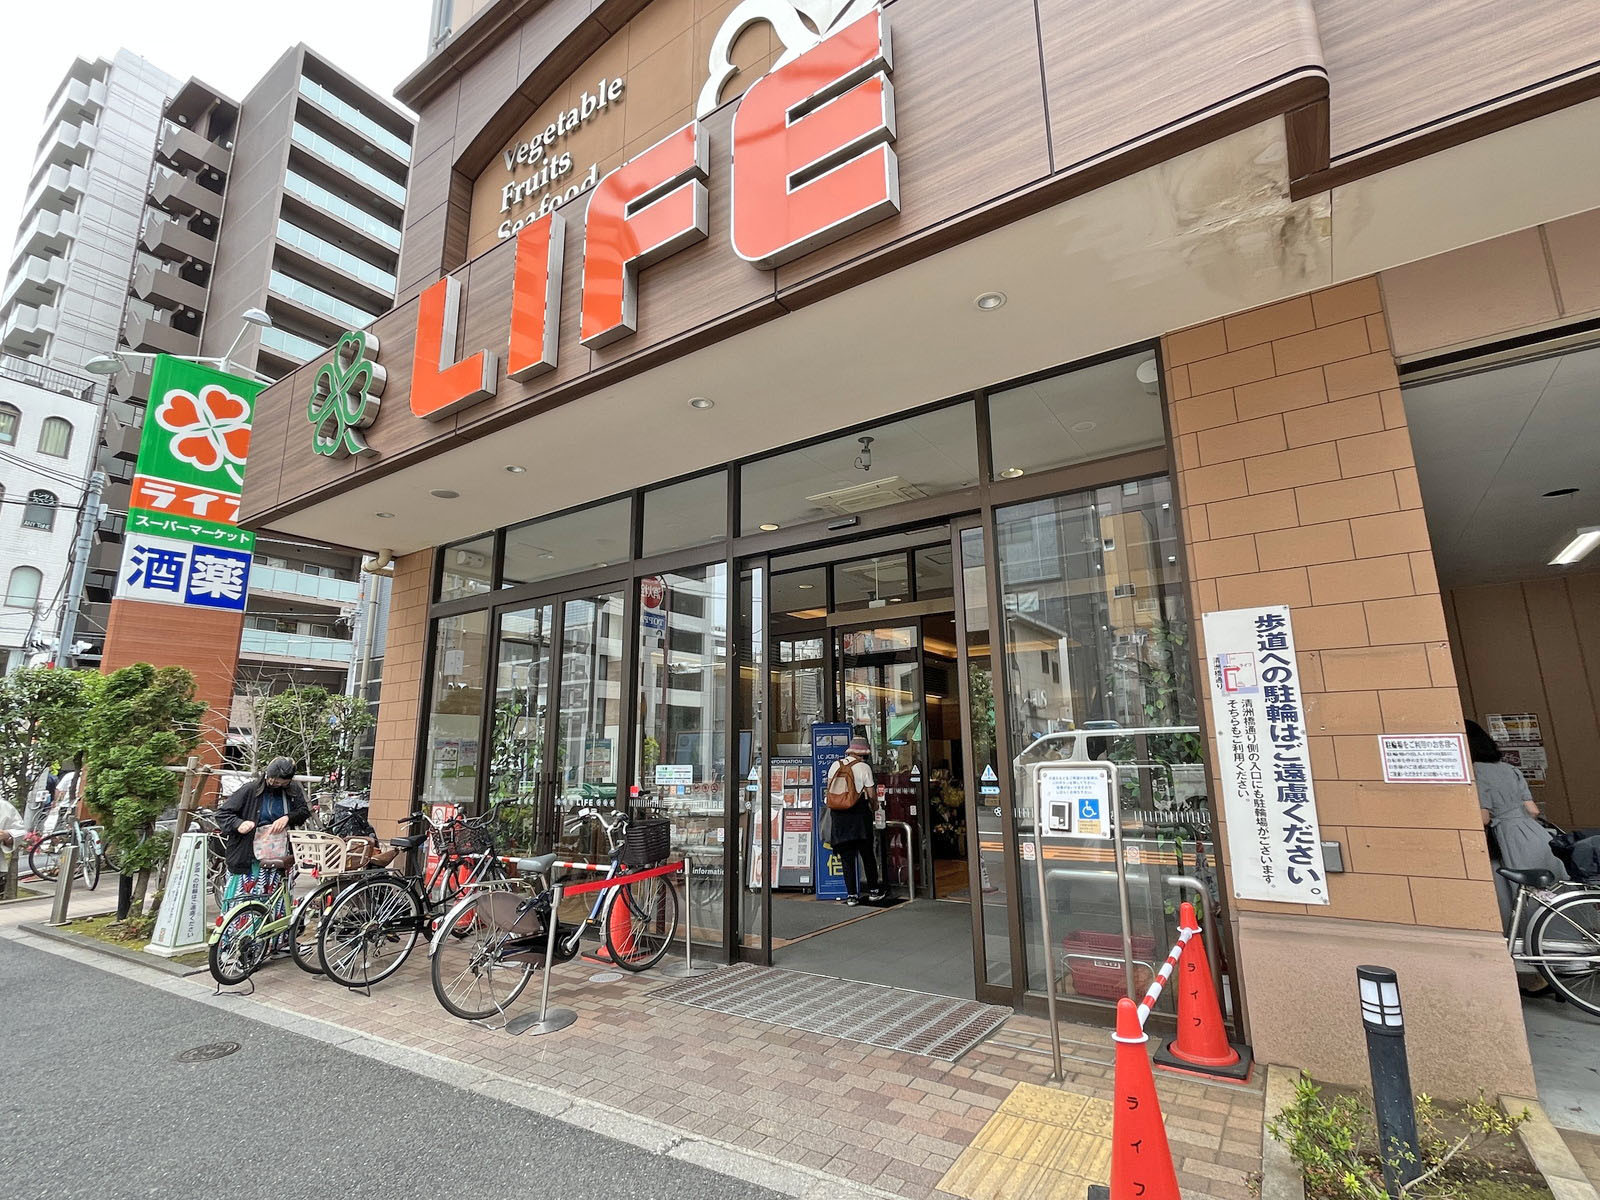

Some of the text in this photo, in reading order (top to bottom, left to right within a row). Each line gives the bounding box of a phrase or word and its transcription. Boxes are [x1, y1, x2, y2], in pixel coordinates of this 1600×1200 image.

[502, 77, 624, 172] Vegetable
[409, 5, 896, 418] LIFE
[499, 151, 572, 214] Fruits
[135, 514, 251, 544] スーパーマーケット
[126, 544, 246, 601] 酒 薬
[1226, 698, 1251, 803] そちらもご利用ください。
[1254, 613, 1322, 896] 歩道への駐輪はご遠慮ください。
[576, 798, 594, 807] LIFE
[1186, 961, 1203, 1028] ライフ
[1125, 1096, 1147, 1197] ライフ
